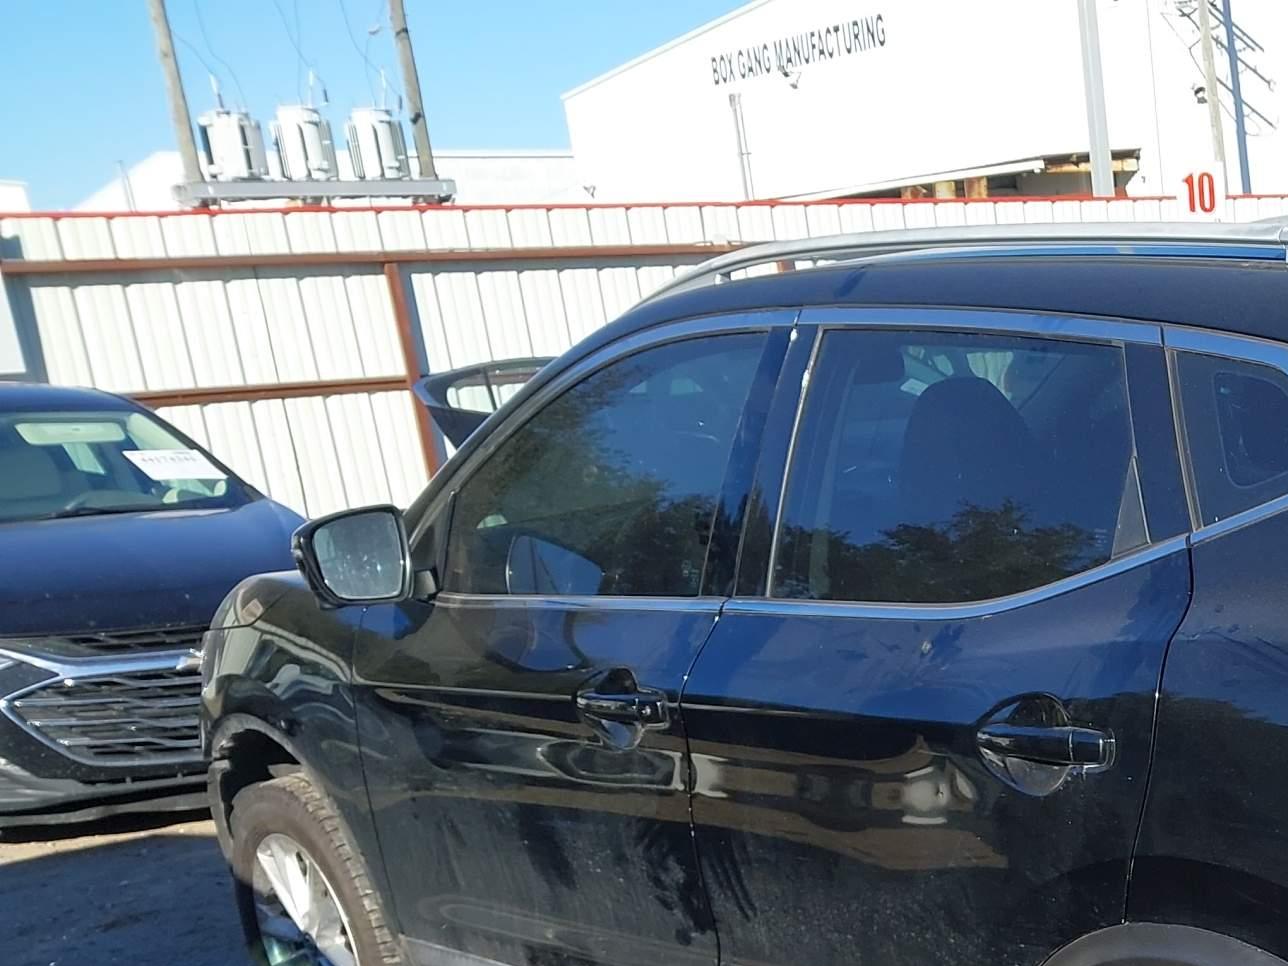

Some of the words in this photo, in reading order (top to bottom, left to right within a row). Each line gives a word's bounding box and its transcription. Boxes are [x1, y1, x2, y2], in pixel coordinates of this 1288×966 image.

[711, 52, 736, 85] BOX
[737, 43, 772, 79] GANG
[773, 13, 887, 71] MANUFACTURING
[1182, 172, 1215, 212] 10
